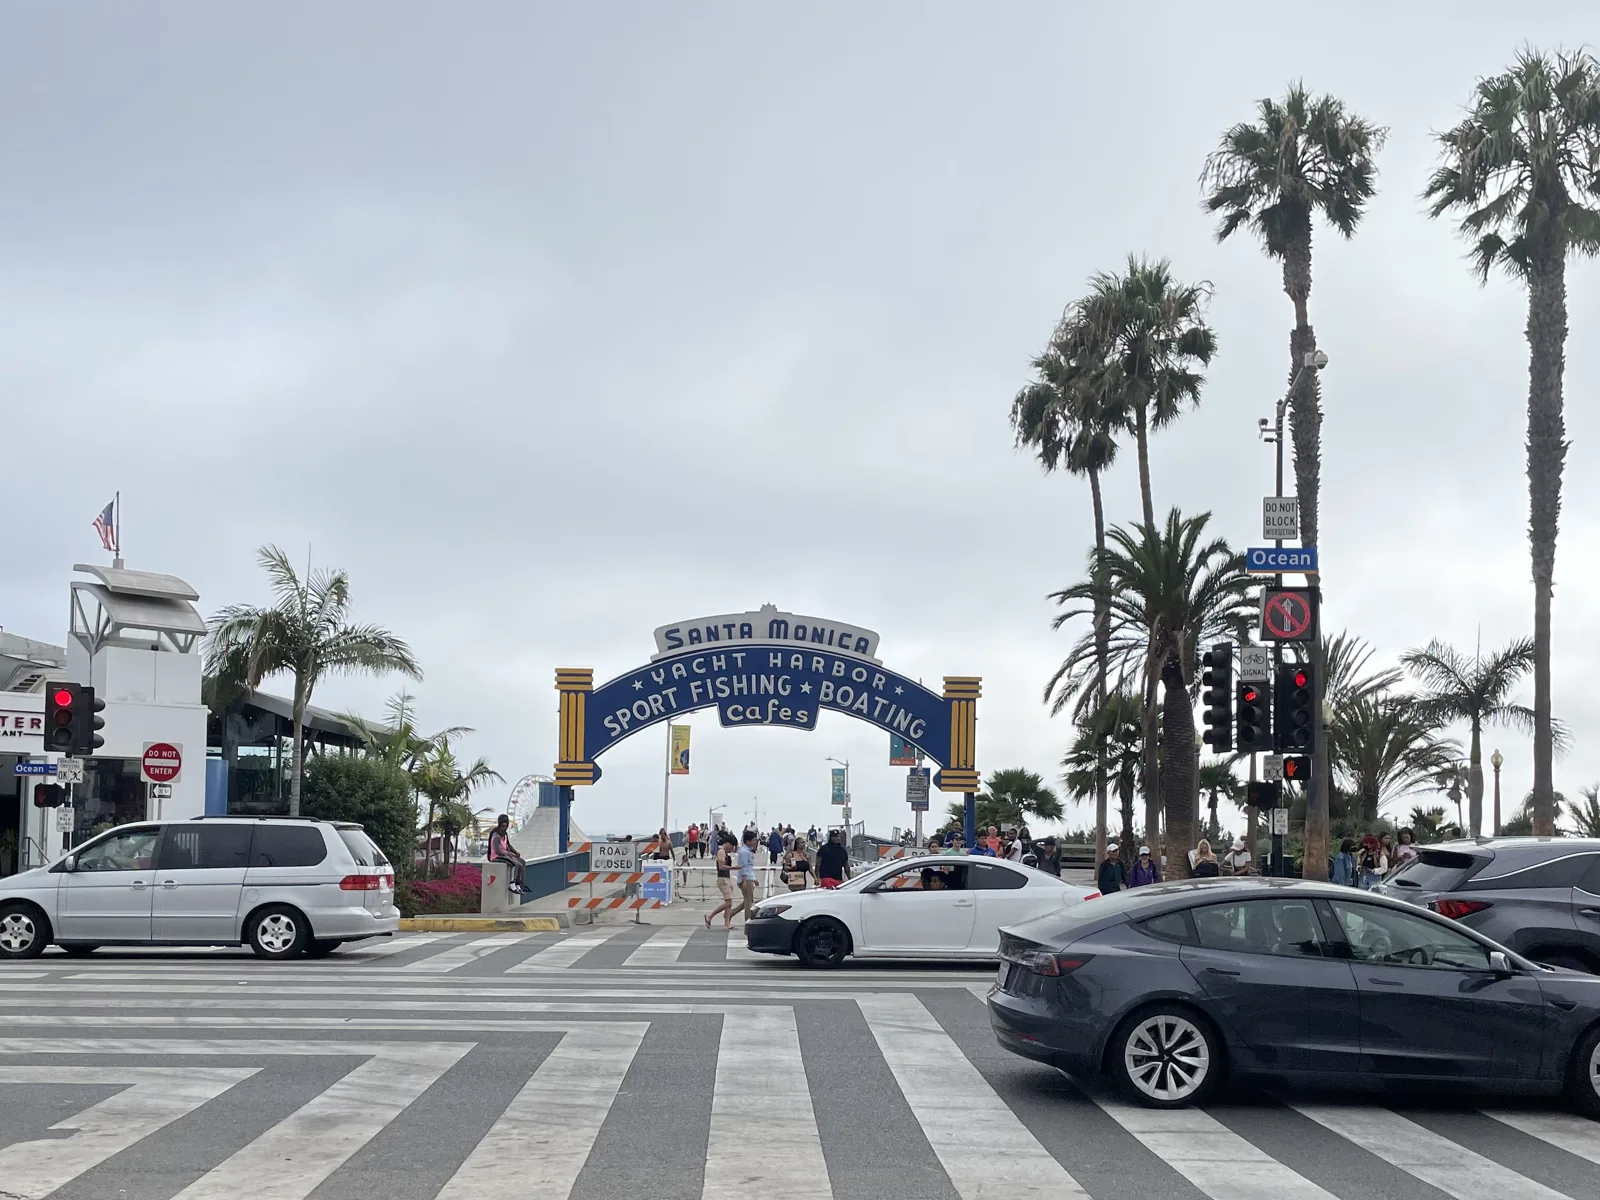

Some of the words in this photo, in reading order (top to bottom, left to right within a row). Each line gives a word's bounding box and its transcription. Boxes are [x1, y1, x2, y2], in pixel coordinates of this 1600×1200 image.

[1266, 502, 1276, 513] DO
[1279, 502, 1295, 513] NOT
[1266, 516, 1295, 526] BLOCK
[1266, 528, 1295, 536] INTERSECTION
[1252, 550, 1311, 566] Ocean
[664, 622, 752, 650] SANTA
[769, 619, 870, 655] MONICA
[650, 652, 746, 685] YACHT
[769, 652, 886, 690] HARBOR
[1242, 668, 1265, 676] SIGNAL
[603, 687, 678, 738] SPORT
[690, 674, 792, 703] FISHING
[819, 679, 926, 739] BOATING
[15, 764, 45, 773] Ocean
[150, 767, 173, 775] ENTER
[58, 770, 68, 780] OK
[599, 846, 629, 856] ROAD
[594, 859, 633, 869] CLOSED
